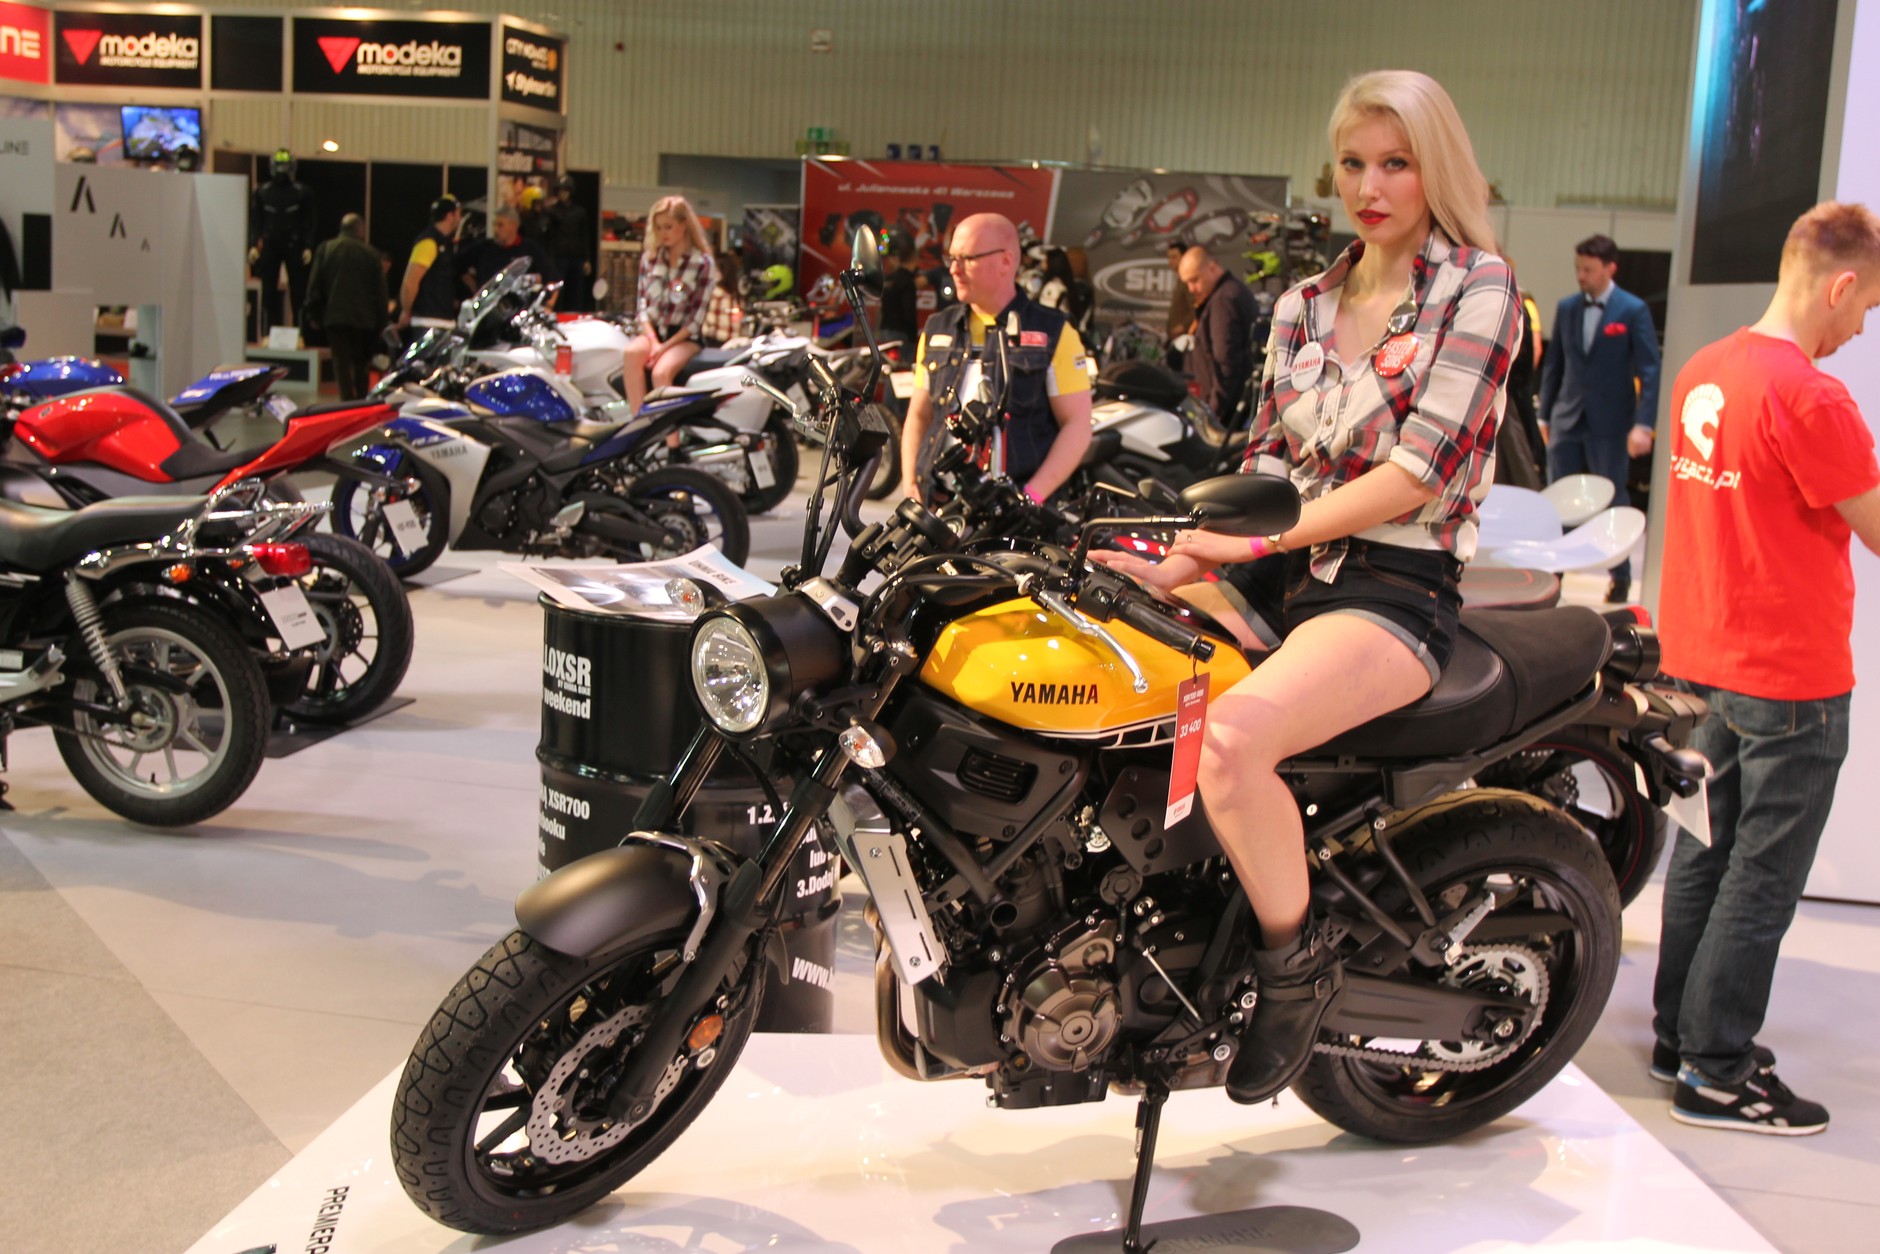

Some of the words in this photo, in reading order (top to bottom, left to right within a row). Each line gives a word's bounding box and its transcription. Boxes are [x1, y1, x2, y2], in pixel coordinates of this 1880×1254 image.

[99, 32, 199, 58] modeka
[356, 40, 462, 66] modeka
[1010, 681, 1099, 705] YAMAHA
[548, 787, 591, 820] XSR700
